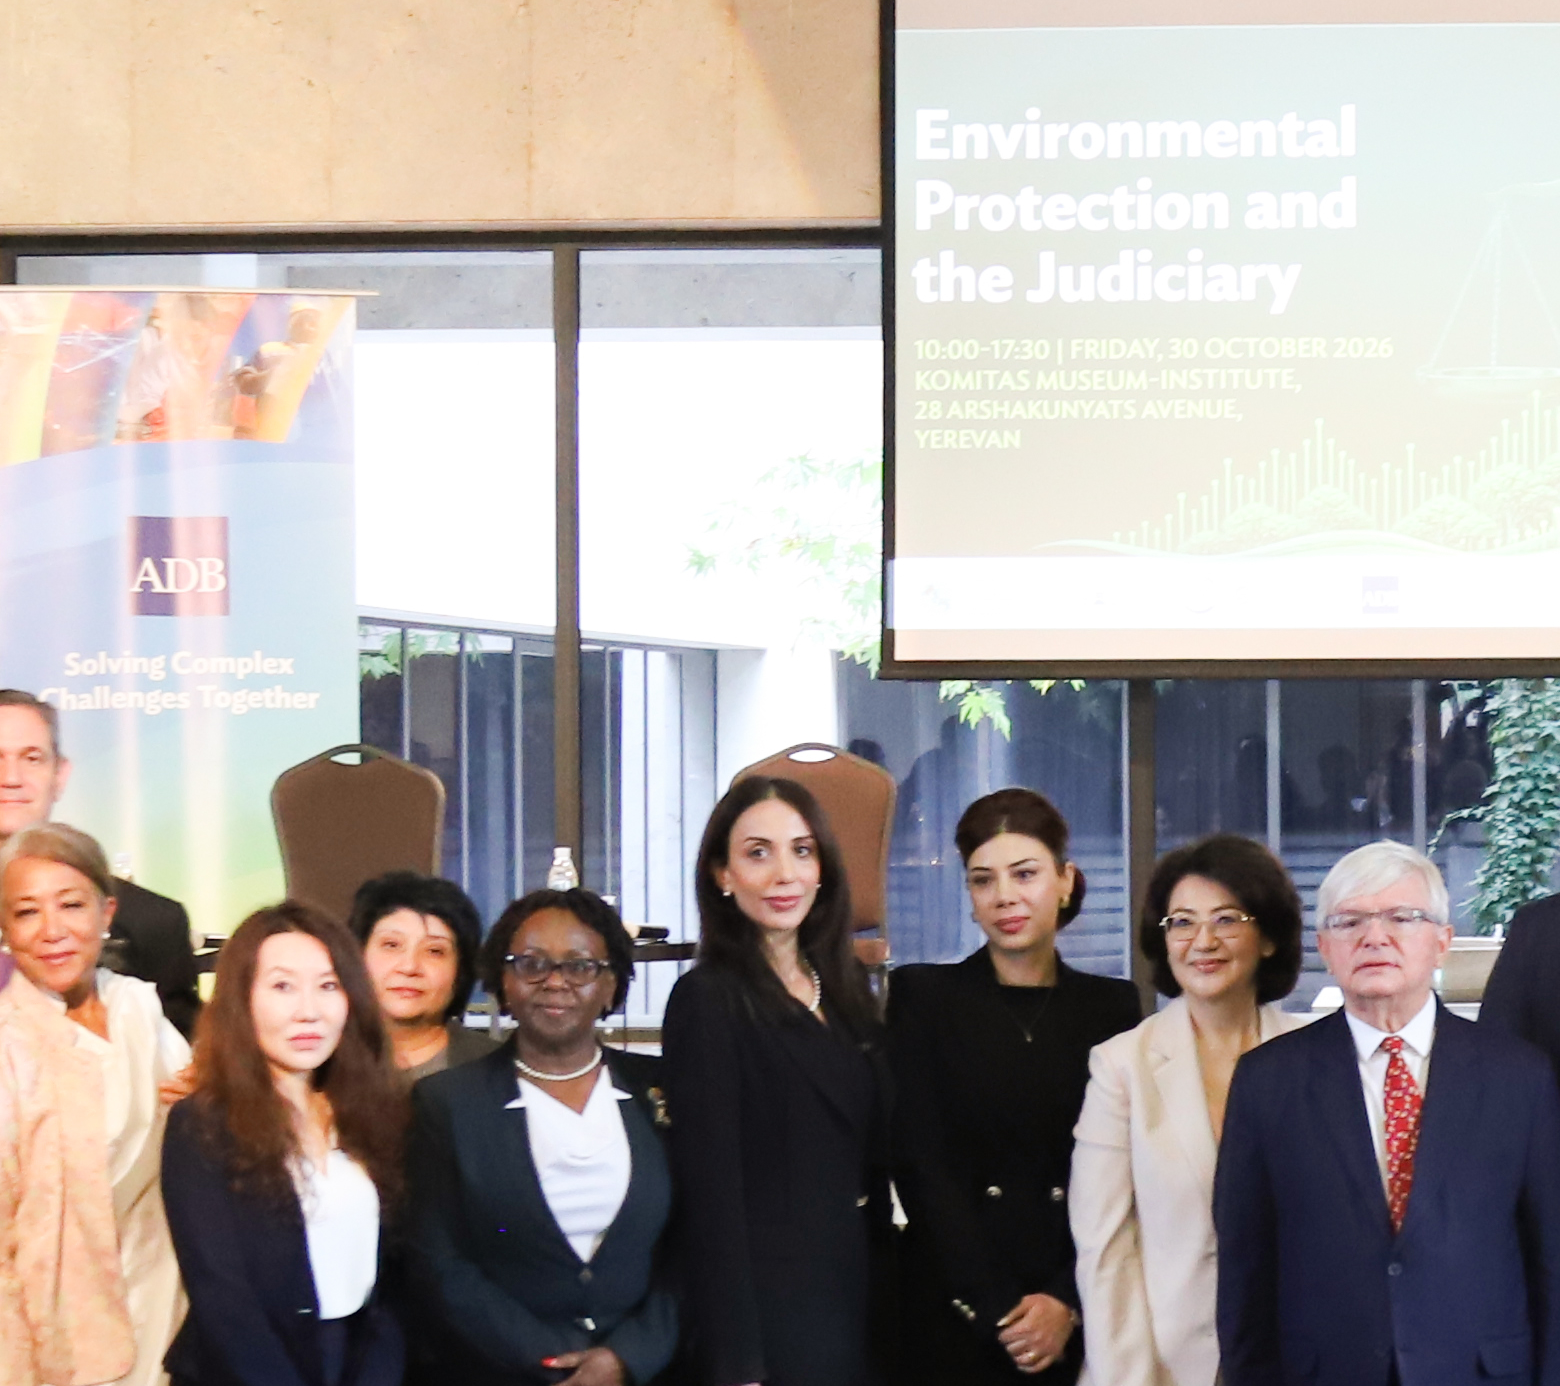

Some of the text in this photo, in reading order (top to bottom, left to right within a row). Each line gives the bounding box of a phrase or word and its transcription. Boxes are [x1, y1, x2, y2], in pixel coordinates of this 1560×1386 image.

[915, 104, 1356, 160] Environmental
[915, 175, 1357, 232] Protection and
[912, 248, 1302, 315] the Judiciary
[1070, 338, 1164, 363] FRIDAY,
[1167, 338, 1199, 360] 30
[1204, 337, 1327, 360] OCTOBER
[1332, 336, 1394, 359] 2026
[915, 367, 1302, 393] KOMITAS MUSEUM-INSTITUTE,
[914, 397, 1243, 423] 28 ARSHAKUNYATS AVENUE,
[914, 429, 1021, 449] YEREVAN
[129, 556, 227, 593] ADB
[64, 649, 295, 681] Solving Complex
[195, 684, 321, 715] Together
